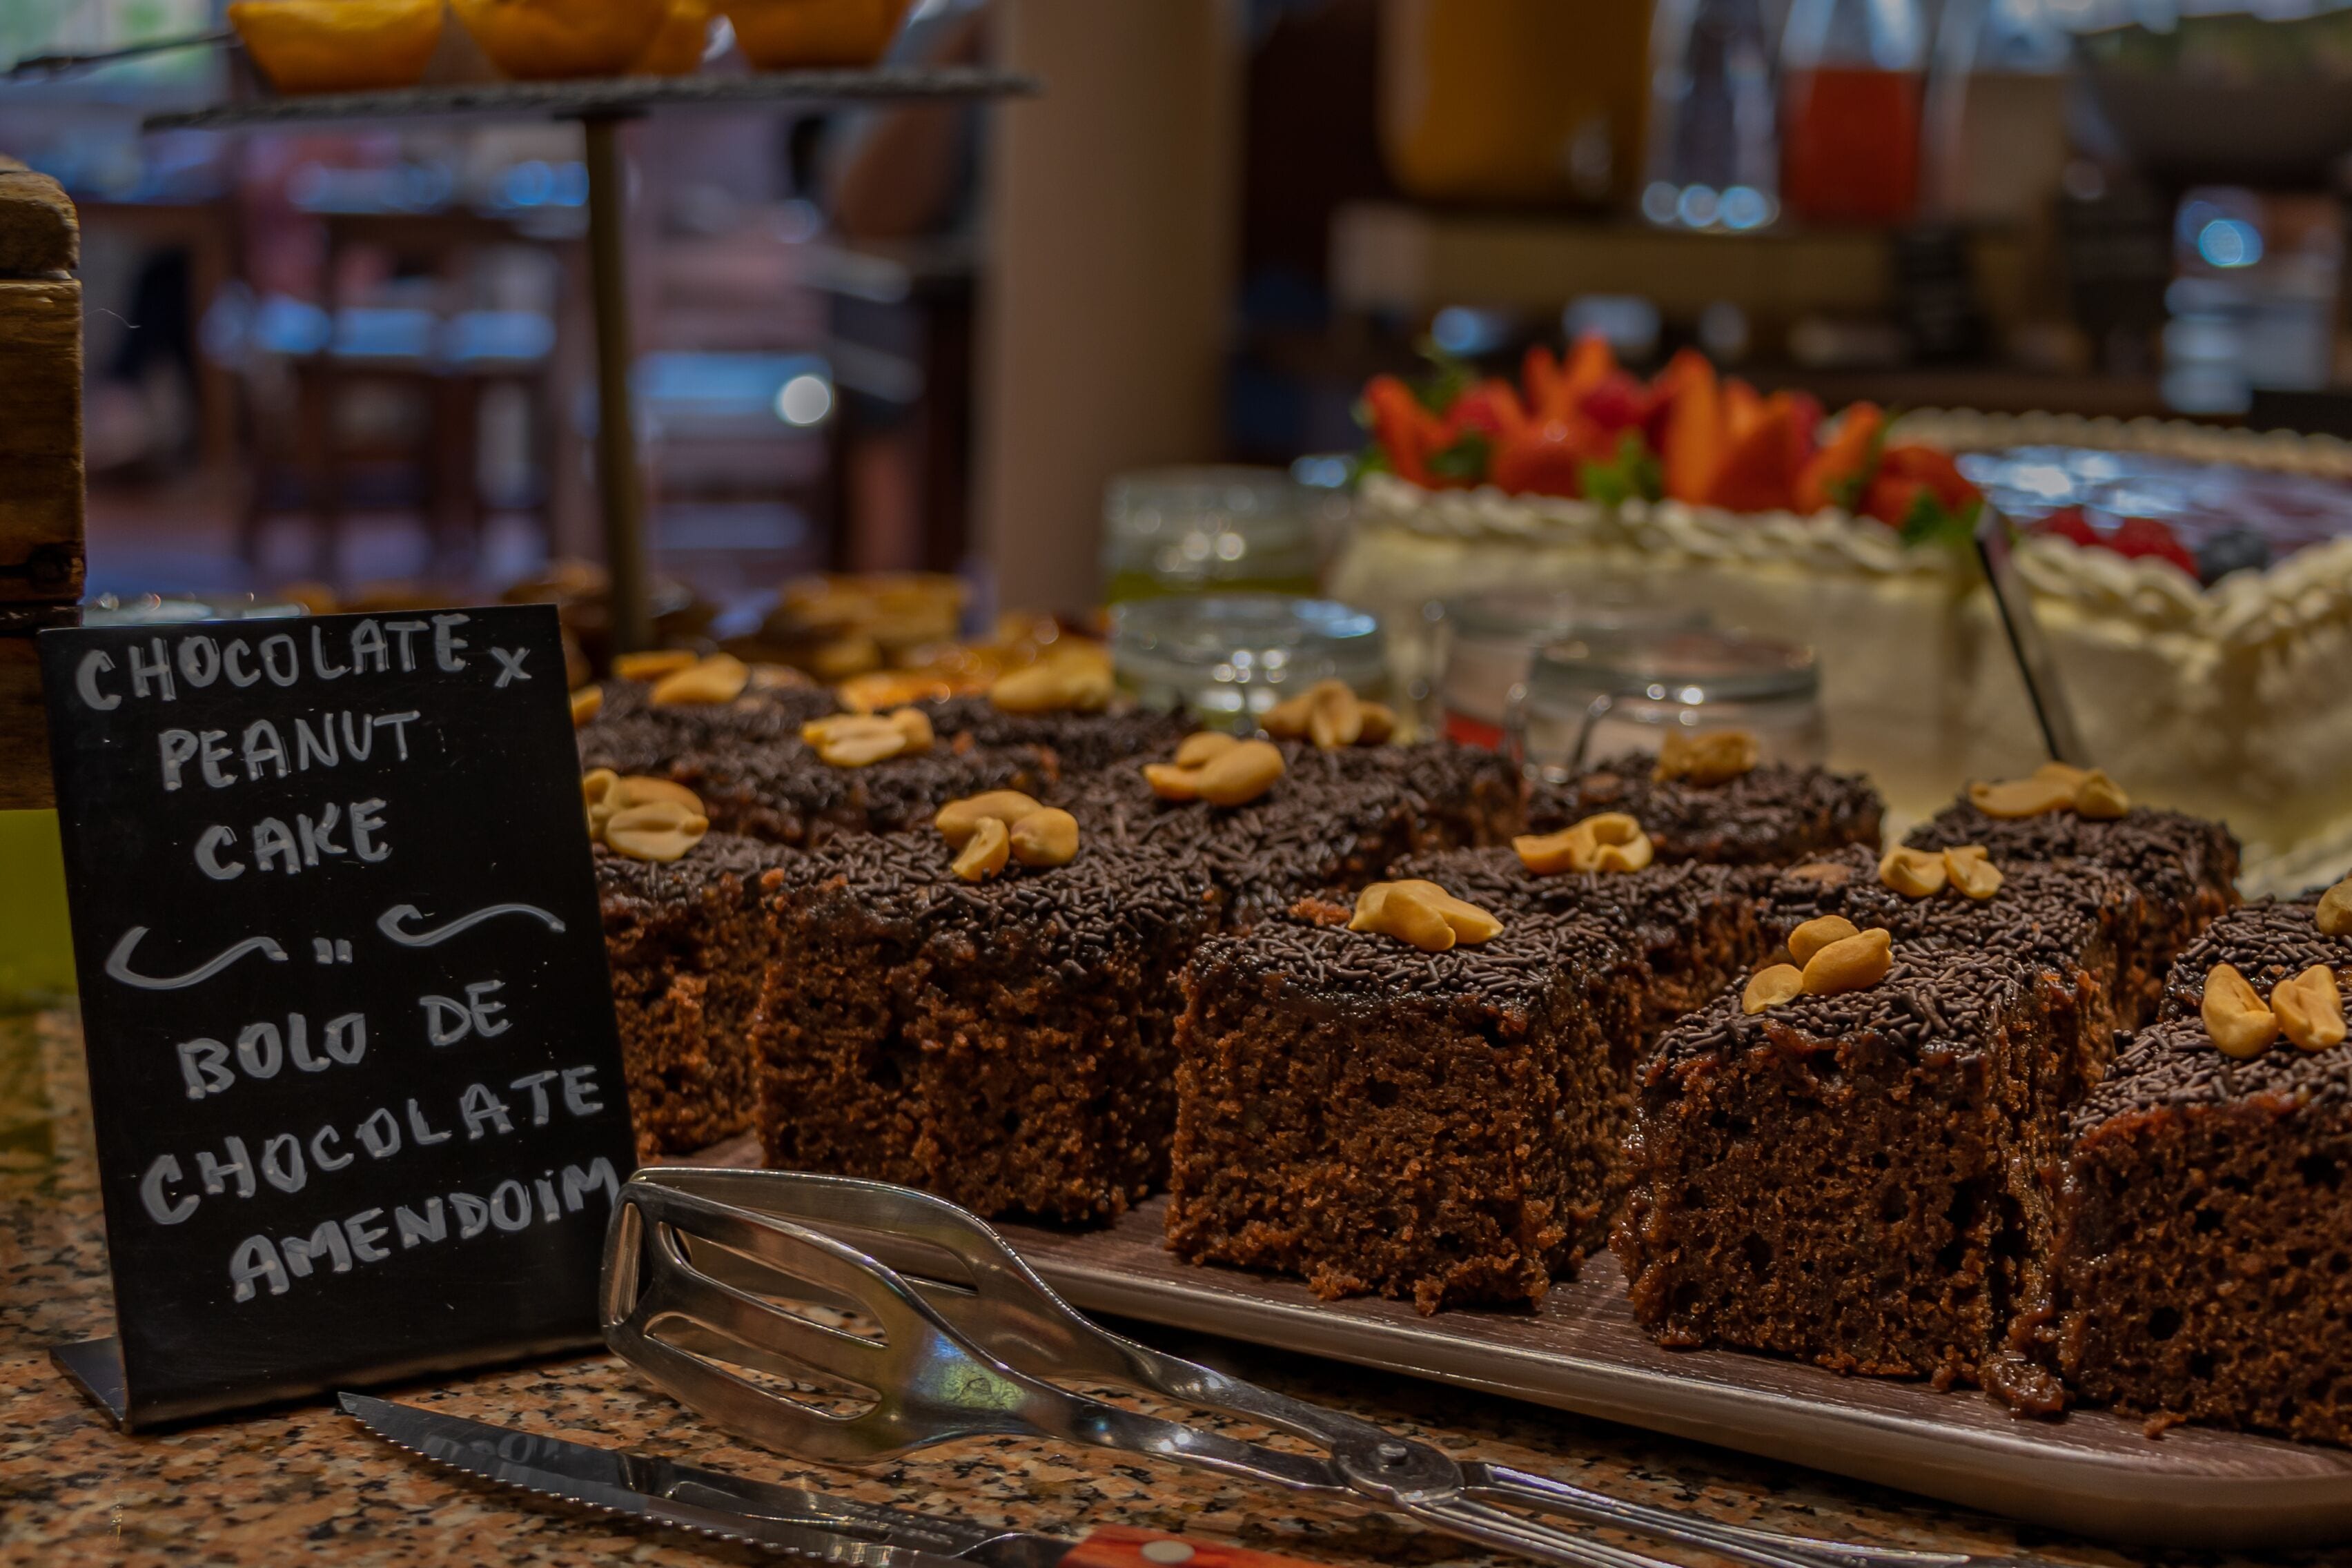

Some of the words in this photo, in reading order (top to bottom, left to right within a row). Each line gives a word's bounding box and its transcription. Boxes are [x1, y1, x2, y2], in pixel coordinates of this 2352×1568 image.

[77, 614, 470, 710] CHOCOLATE
[159, 710, 420, 790] PEANUT
[195, 798, 392, 879] CAKE
[177, 1012, 366, 1099] BOLO
[420, 980, 513, 1046] DE
[141, 1066, 603, 1224] CHOCOLATE
